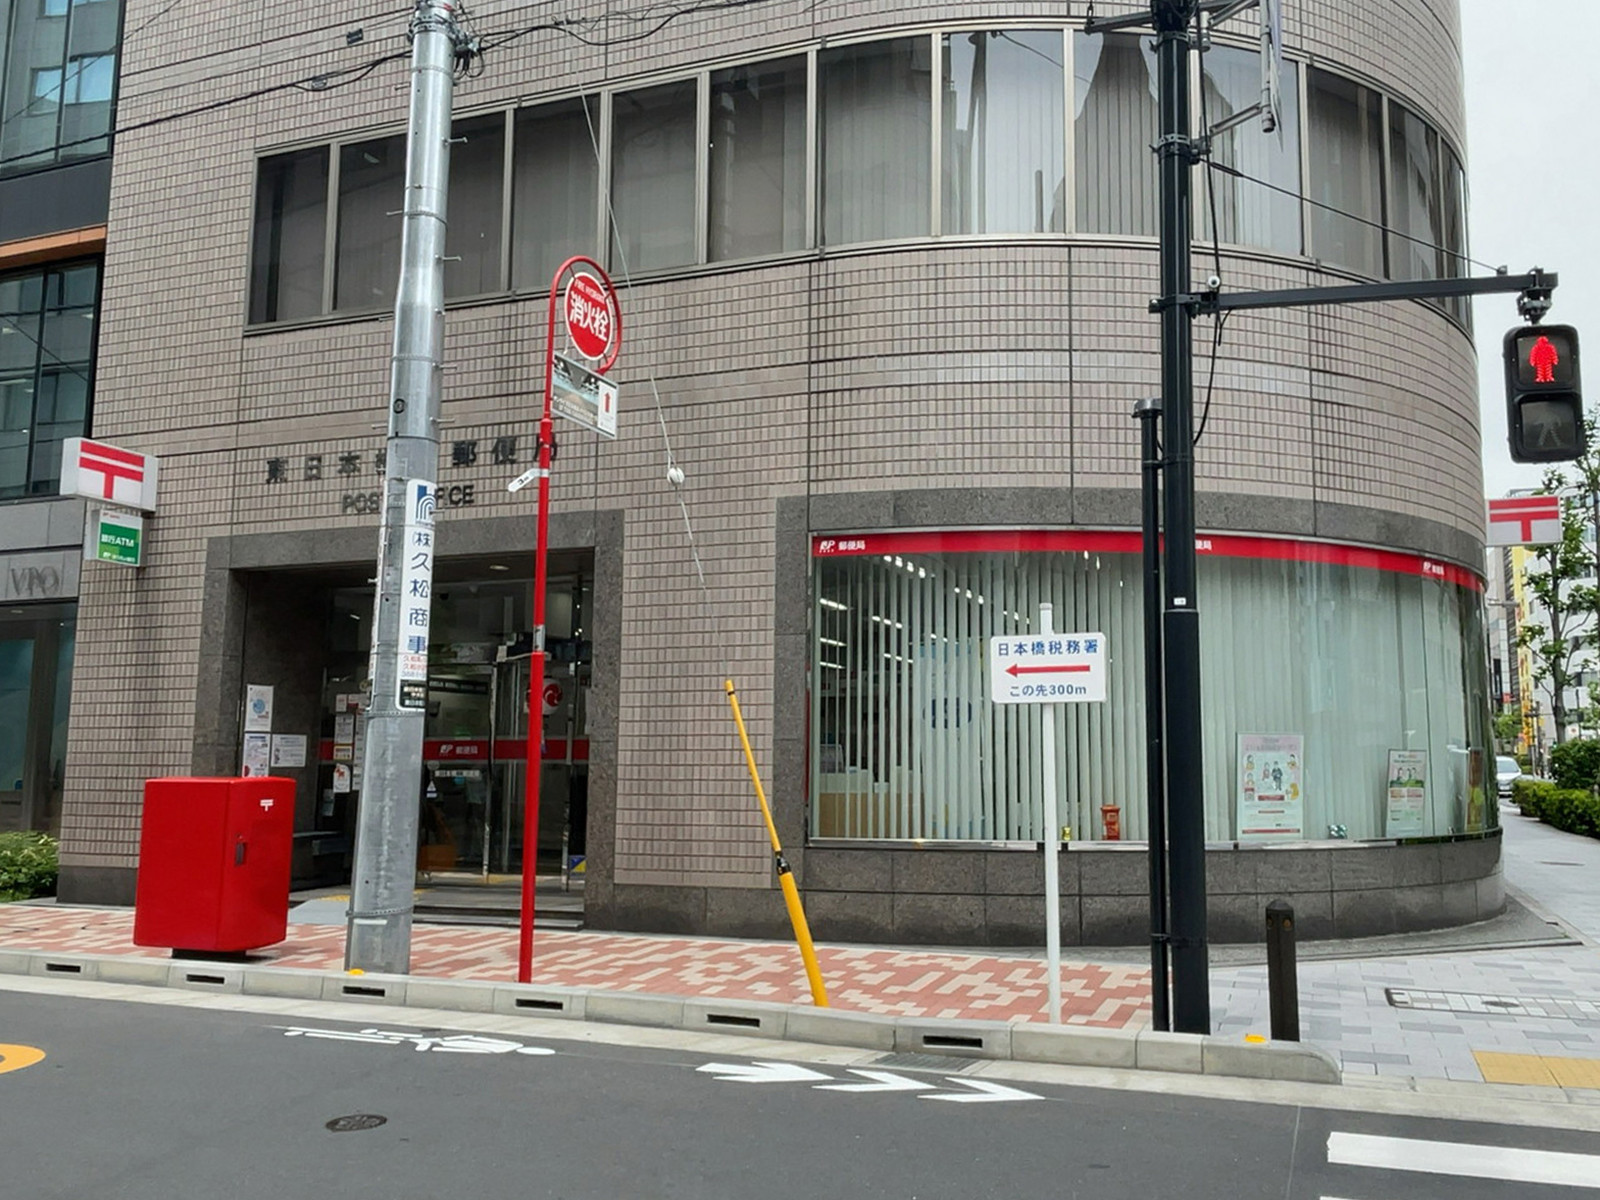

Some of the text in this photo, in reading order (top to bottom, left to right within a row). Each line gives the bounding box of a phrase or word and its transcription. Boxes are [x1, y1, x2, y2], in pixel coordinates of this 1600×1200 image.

[570, 291, 609, 341] 消火栓
[266, 433, 557, 484] 東日本郵便局
[1195, 539, 1212, 551] 便局
[998, 639, 1098, 656] 日本橋税務署
[1010, 684, 1087, 697] この先300m
